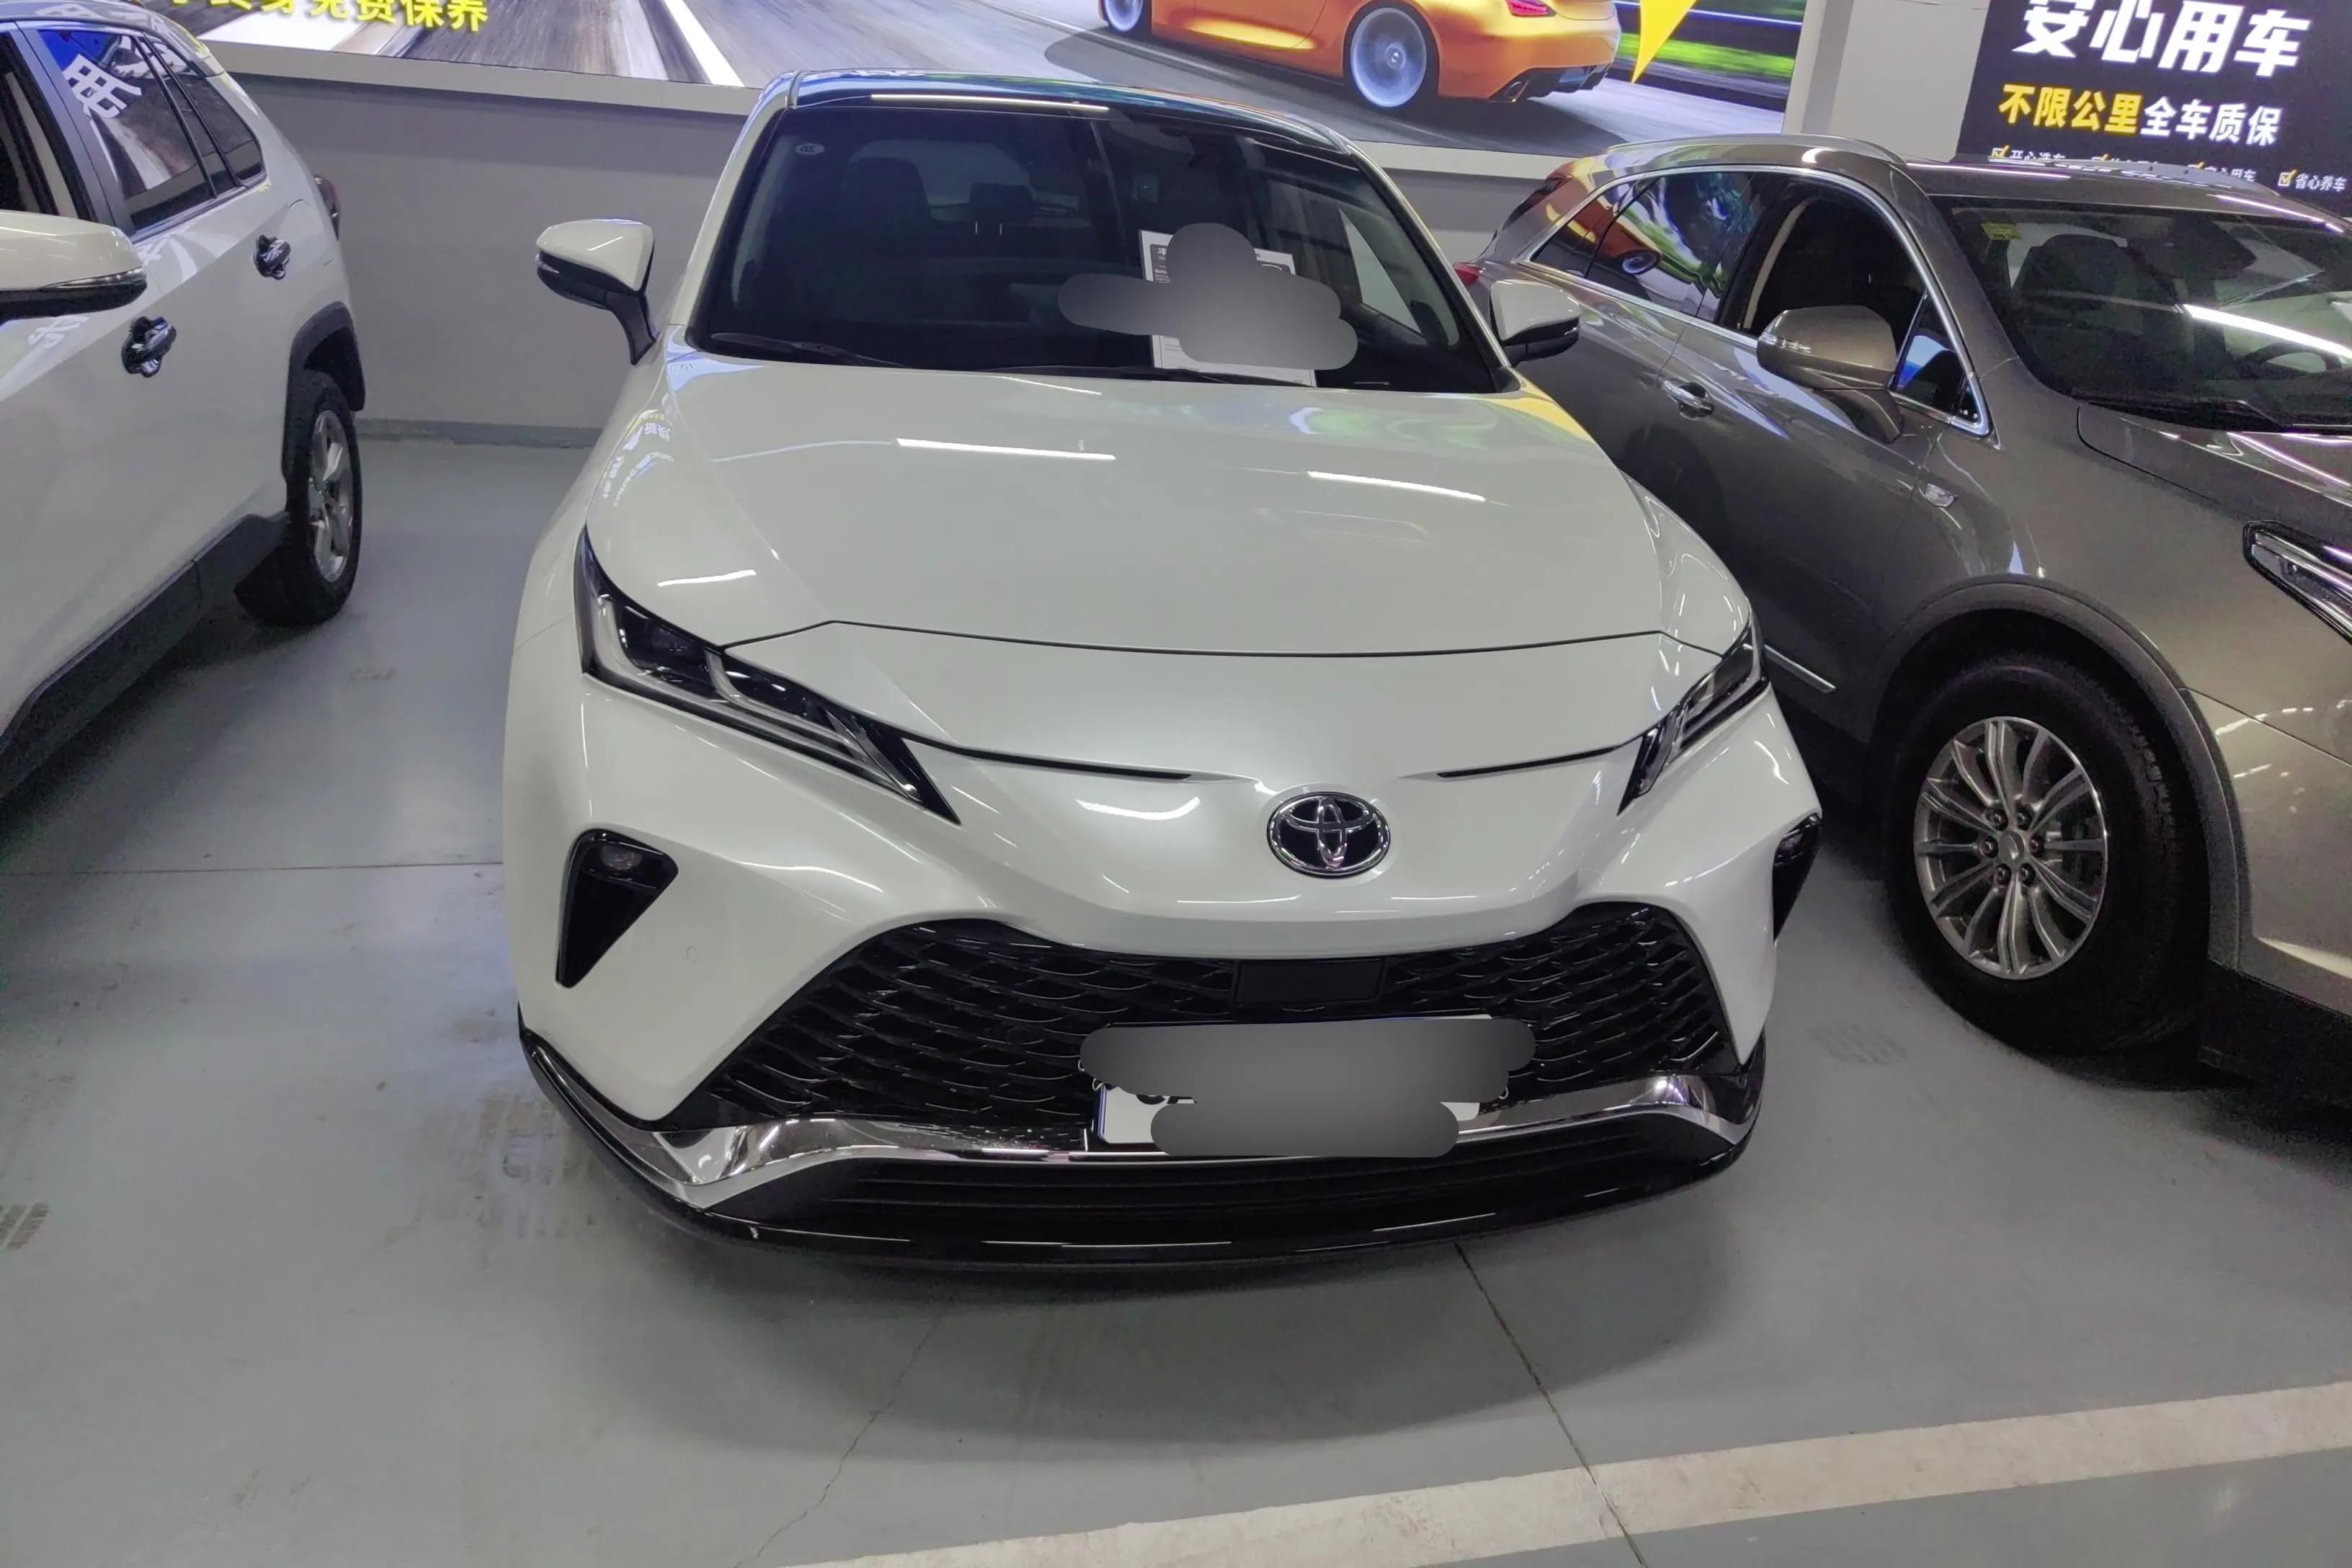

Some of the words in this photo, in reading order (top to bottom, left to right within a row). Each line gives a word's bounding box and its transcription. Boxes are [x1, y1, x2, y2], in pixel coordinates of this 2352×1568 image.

[2012, 0, 2312, 77] 安心用车
[1997, 84, 2284, 146] 不限公里全车质保
[2295, 173, 2348, 192] 省心养车
